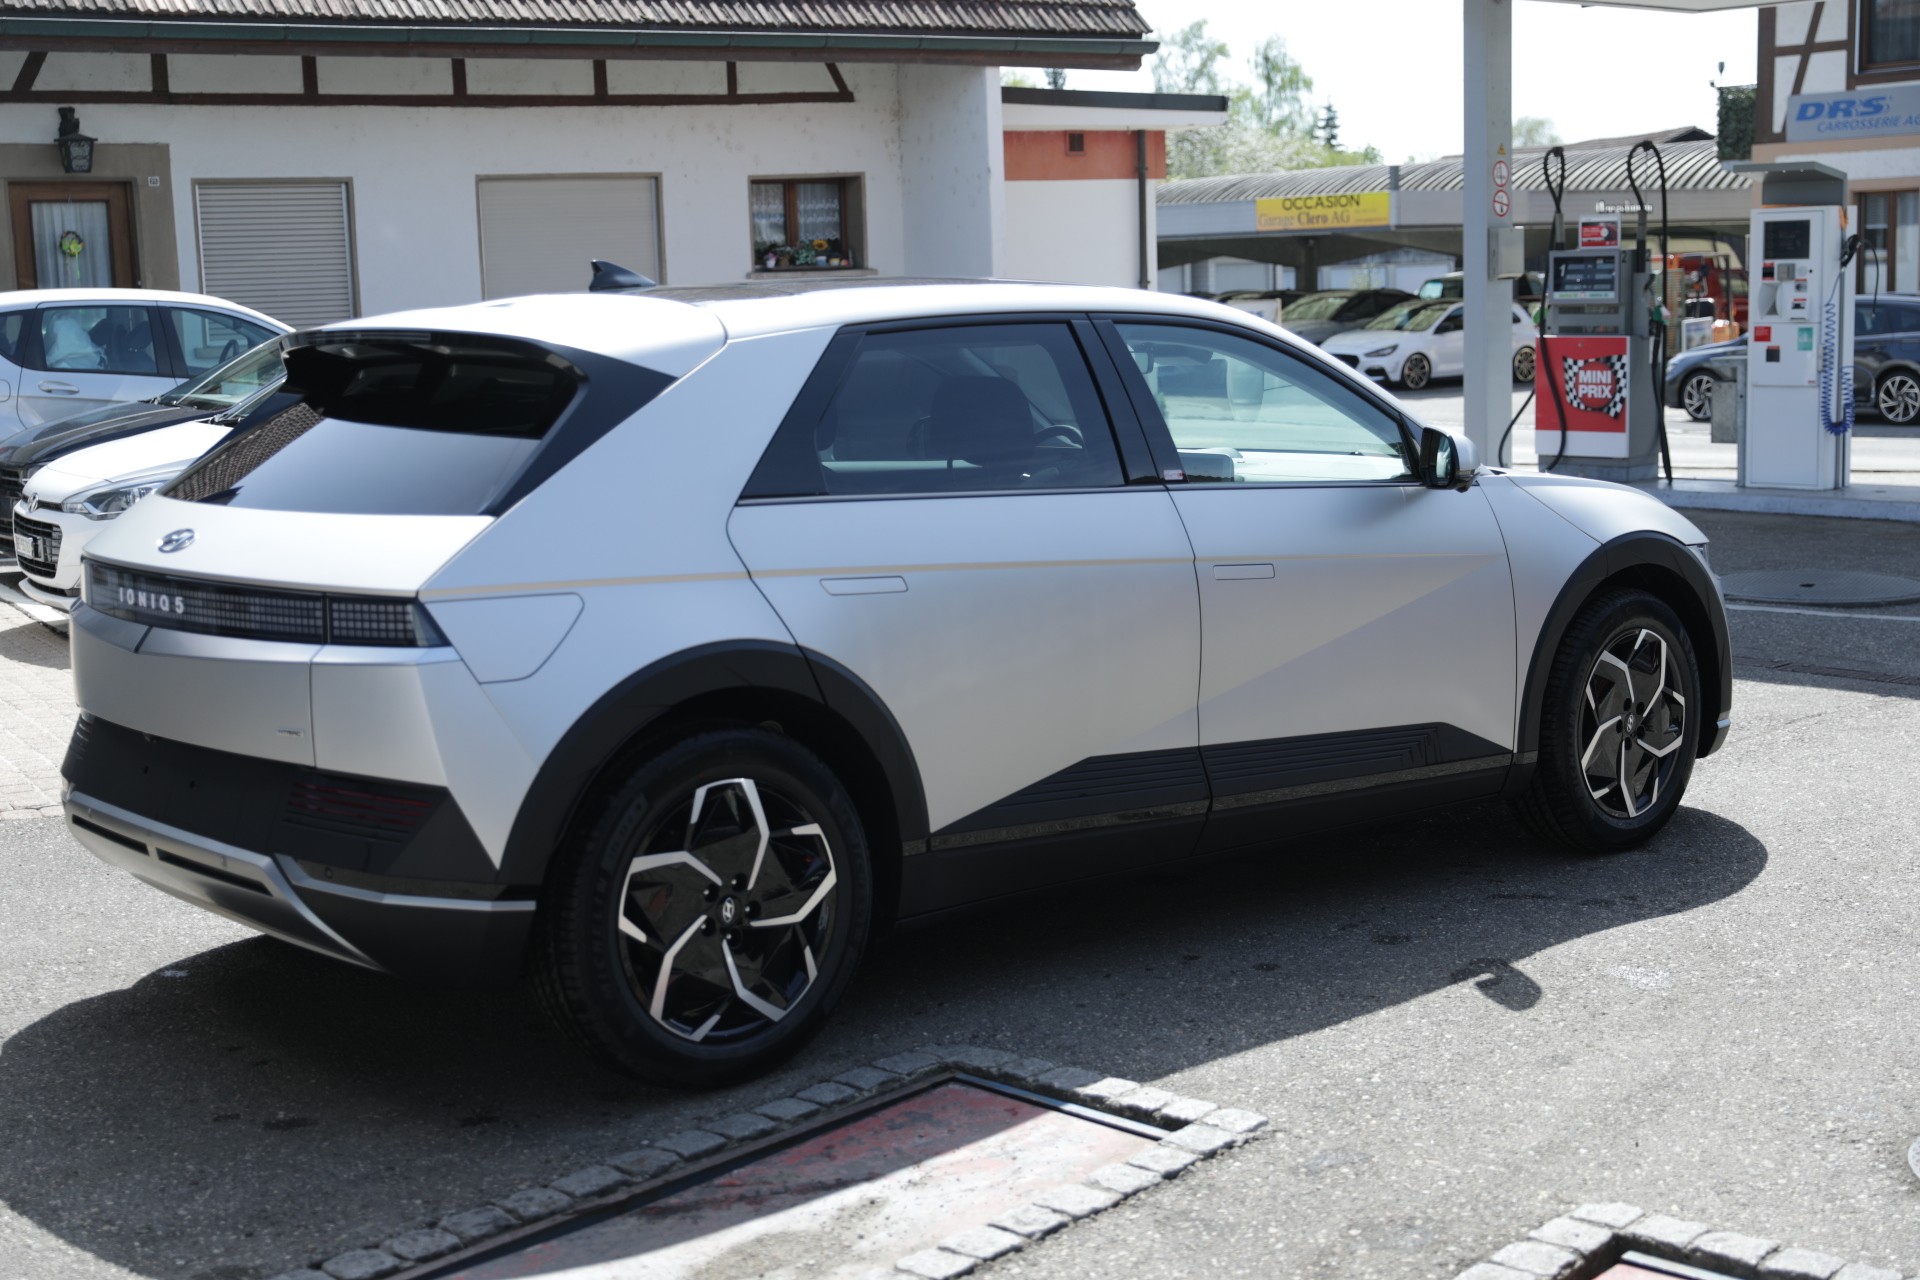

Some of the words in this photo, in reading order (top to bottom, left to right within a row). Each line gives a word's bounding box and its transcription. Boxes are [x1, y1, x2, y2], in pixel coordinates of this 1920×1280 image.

[1795, 96, 1887, 122] DRS
[1817, 115, 1901, 132] CARROSSERIE
[1282, 194, 1360, 211] OCCASION
[1298, 211, 1328, 226] Clero
[1331, 210, 1351, 225] AG
[1579, 370, 1612, 384] MINI
[1578, 385, 1612, 399] PRIX
[119, 586, 170, 612] IONIQ
[175, 596, 184, 614] 5
